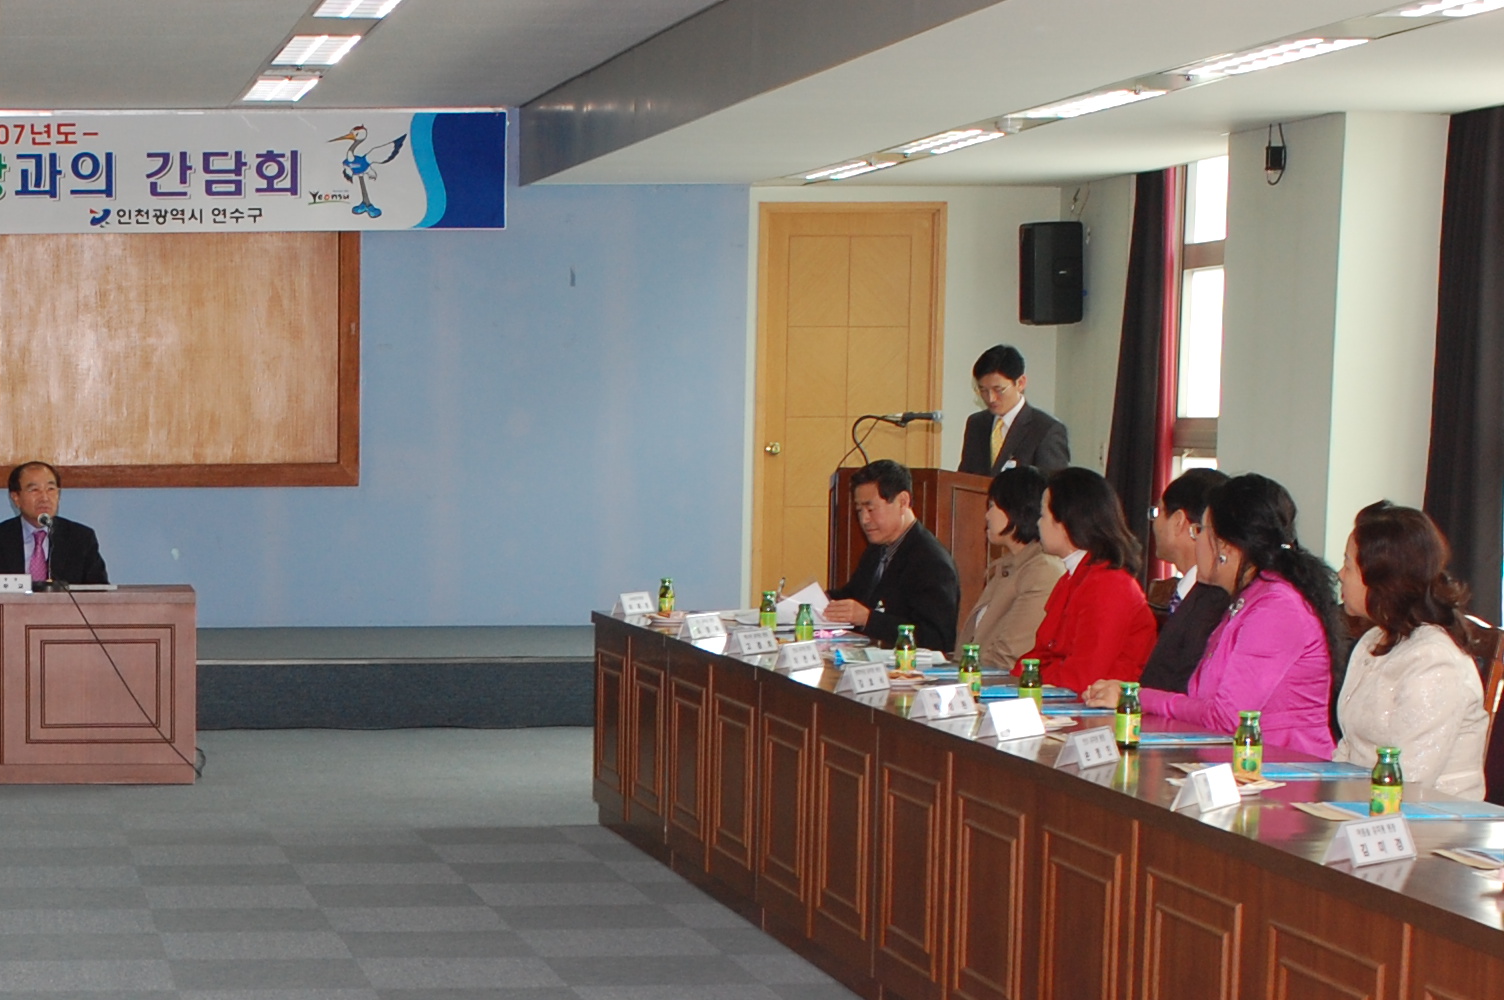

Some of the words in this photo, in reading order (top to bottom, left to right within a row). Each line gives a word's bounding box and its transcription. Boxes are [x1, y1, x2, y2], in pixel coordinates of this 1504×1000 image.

[145, 149, 300, 198] 간담회
[308, 190, 350, 203] Yeonsu
[116, 207, 203, 226] 인천광역시
[211, 206, 263, 225] 연수구
